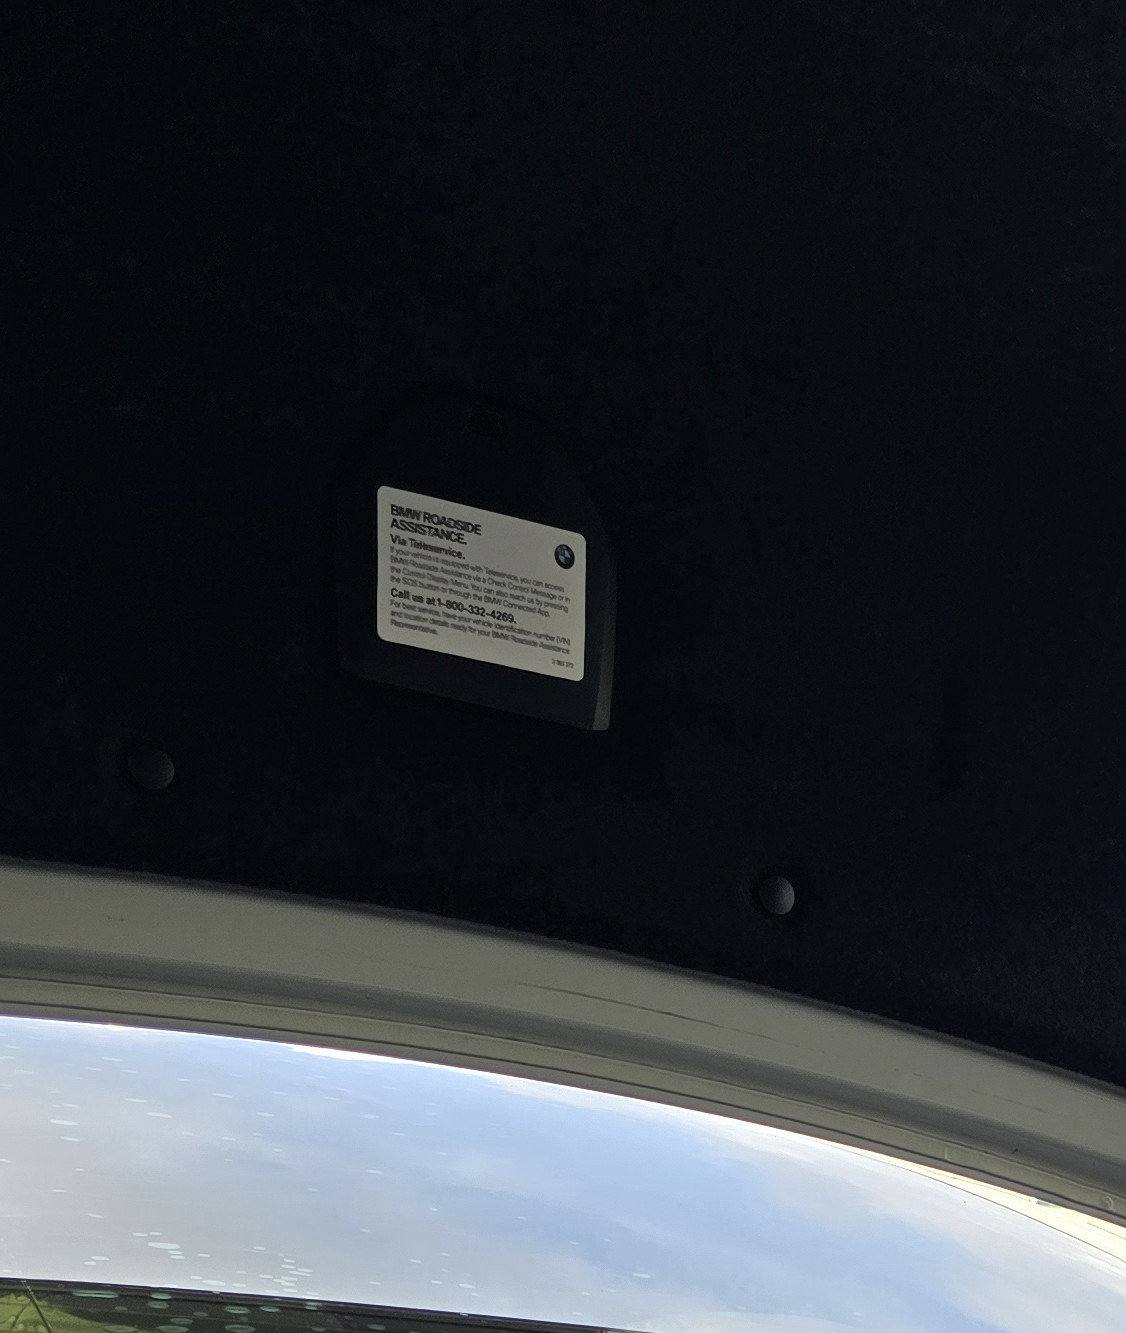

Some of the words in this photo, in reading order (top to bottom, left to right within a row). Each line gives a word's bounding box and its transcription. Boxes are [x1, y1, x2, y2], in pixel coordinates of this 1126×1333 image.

[390, 503, 421, 521] BMW
[423, 511, 481, 536] ROADSIDE
[390, 516, 467, 545] ASSISTANCE.
[390, 533, 407, 546] Via
[408, 537, 465, 560] Teleservice.
[390, 555, 408, 566] BMW
[410, 559, 438, 573] Roadside
[440, 566, 471, 580] Assistance
[473, 574, 481, 582] via
[487, 577, 505, 588] Check
[508, 582, 529, 593] Control
[530, 587, 556, 599] Message
[557, 593, 563, 601] or
[390, 564, 400, 574] the
[470, 583, 482, 592] You
[483, 585, 494, 595] can
[496, 588, 508, 598] also
[509, 591, 525, 602] reach
[527, 595, 534, 604] us
[535, 597, 542, 606] by
[544, 599, 568, 612] pressing
[390, 574, 400, 584] the
[448, 587, 471, 599] through
[472, 592, 482, 602] the
[484, 595, 502, 606] BMW
[503, 599, 536, 613] Connected
[469, 564, 482, 574] with
[520, 576, 531, 585] you
[532, 578, 543, 587] can
[544, 581, 564, 592] access
[390, 599, 400, 608] For
[402, 601, 416, 612] best
[442, 610, 456, 620] have
[457, 613, 470, 623] your
[472, 617, 492, 628] vehicle
[494, 621, 532, 637] identification
[533, 630, 555, 642] number
[556, 635, 570, 645] (VIN)
[391, 587, 410, 600] Call
[412, 592, 423, 603] us
[426, 595, 435, 606] at
[437, 597, 516, 623] 1-800-332-4269.
[390, 609, 402, 619] and
[404, 611, 428, 624] location
[429, 617, 449, 628] details
[450, 622, 467, 632] ready
[468, 625, 476, 634] for
[477, 627, 490, 637] your
[491, 630, 509, 641] BMW
[510, 634, 537, 647] Roadside
[539, 640, 569, 654] Assistance
